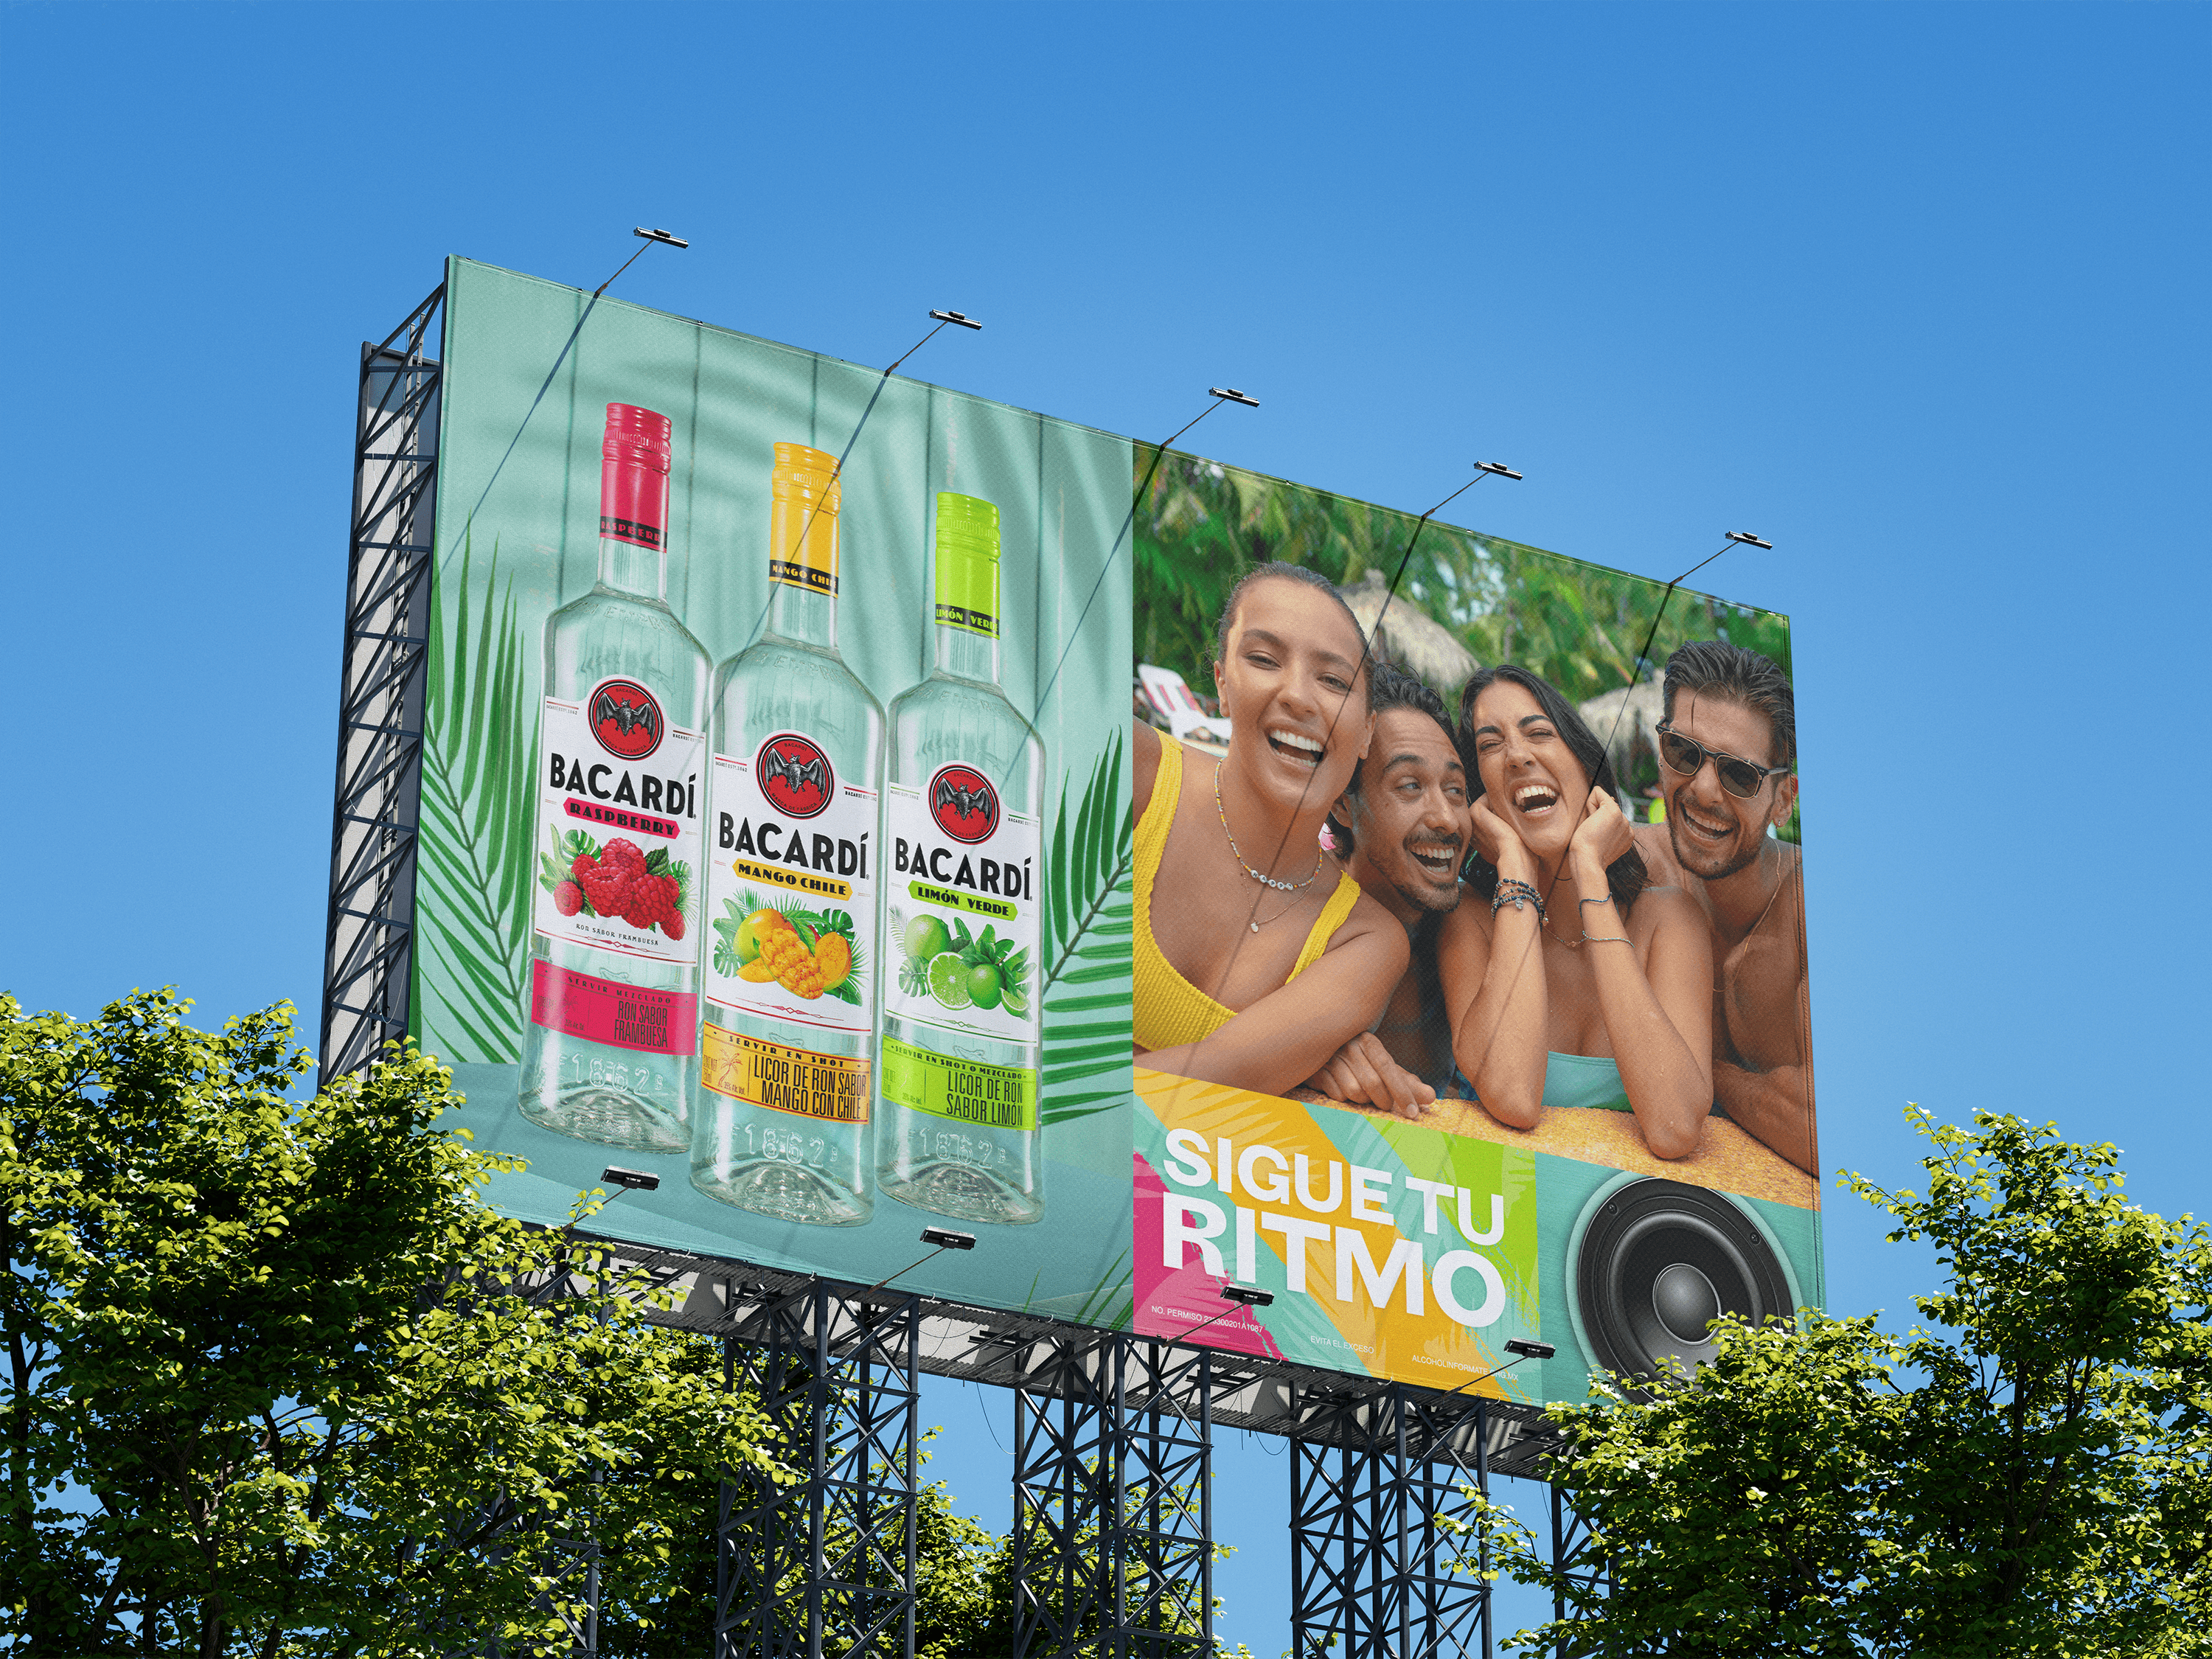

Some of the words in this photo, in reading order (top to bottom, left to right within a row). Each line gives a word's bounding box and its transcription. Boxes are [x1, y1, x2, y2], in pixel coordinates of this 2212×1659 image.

[601, 521, 661, 543] RASPBERR
[772, 565, 807, 579] MANGO
[936, 608, 964, 622] LIMÓN
[549, 752, 697, 819] BACARDÍ
[569, 802, 675, 835] RASPBERRY
[719, 811, 869, 880] BACARDÍ
[738, 863, 797, 885] MANGO
[800, 877, 846, 896] CHILE
[895, 837, 1032, 901] BACARDÍ
[917, 886, 959, 905] LIMÓN
[967, 897, 1009, 917] VERDE
[592, 928, 616, 937] SABOR
[618, 933, 658, 946] FRAMBUESA
[568, 975, 608, 993] SERVIR
[616, 989, 671, 1004] MEZCLADO
[618, 1000, 637, 1022] RON
[639, 1004, 668, 1027] SABOR
[613, 1018, 668, 1048] FRAMBUESA
[728, 1035, 777, 1054] SERVIR
[787, 1051, 802, 1060] EN
[811, 1056, 844, 1068] SHOT
[894, 1046, 922, 1060] SERVIR
[926, 1055, 937, 1064] EN
[940, 1058, 967, 1071] SHOT
[978, 1067, 1022, 1080] MEZCLADO
[754, 1054, 790, 1085] LICOR
[793, 1064, 809, 1089] DE
[812, 1068, 835, 1093] RON
[838, 1072, 866, 1097] SABOR
[947, 1070, 982, 1098] LICOR
[987, 1078, 1000, 1101] DE
[1004, 1081, 1023, 1104] RON
[761, 1080, 809, 1113] MANGO
[812, 1091, 835, 1117] CON
[837, 1095, 861, 1119] CHILE
[946, 1093, 987, 1121] SABOR
[991, 1102, 1023, 1127] LIMÓN
[1162, 1127, 1395, 1226] SIGUE
[1405, 1175, 1505, 1246] TU
[1162, 1190, 1506, 1328] RITMO
[1151, 1305, 1166, 1315] NO.
[1167, 1308, 1203, 1321] PERMISO
[1310, 1335, 1332, 1346] EVITA
[1332, 1339, 1342, 1349] EL
[1343, 1341, 1374, 1354] EXCESO
[1411, 1354, 1519, 1382] ALCOHOLINFORMATEORG.MX
